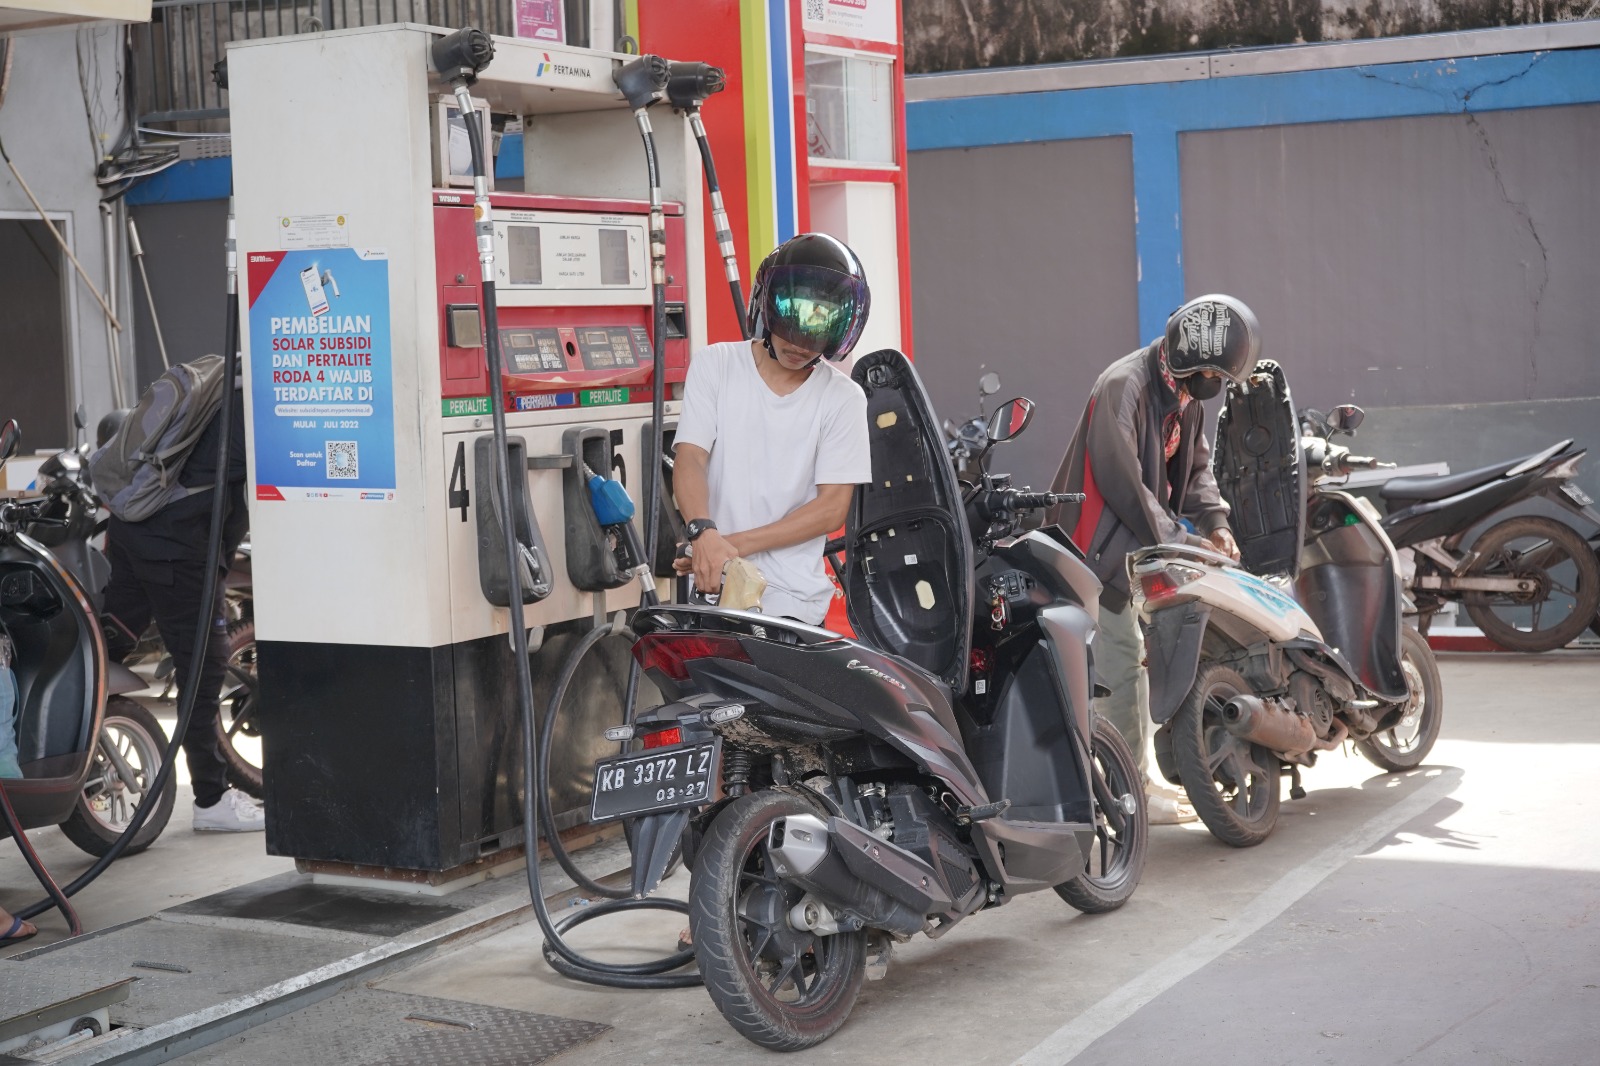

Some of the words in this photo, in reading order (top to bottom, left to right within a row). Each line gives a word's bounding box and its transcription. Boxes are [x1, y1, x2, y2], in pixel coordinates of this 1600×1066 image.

[554, 65, 591, 78] PERTAMINA
[271, 315, 371, 335] PEMBELIAN
[272, 338, 315, 351] SOLAR
[320, 336, 371, 350] SUBSIDI
[272, 354, 303, 368] DAN
[307, 353, 372, 367] PERTALITE
[273, 370, 312, 384] RODA
[316, 370, 325, 383] 4
[329, 369, 373, 384] WAJIB
[273, 386, 354, 402] TERDAFTAR
[358, 386, 373, 401] DI
[589, 389, 622, 404] PERTALITE
[450, 398, 488, 414] PERTALITE
[509, 397, 515, 409] 2
[521, 394, 558, 411] PERTAMAX
[293, 421, 316, 429] MULAI
[323, 421, 338, 429] JULI
[340, 420, 359, 429] 2022
[290, 451, 304, 459] Scan
[305, 451, 323, 459] untuk
[609, 428, 627, 489] 5
[296, 459, 317, 467] Daftar
[449, 441, 469, 522] 4
[602, 768, 625, 791] KB
[633, 758, 677, 785] 3372
[686, 751, 710, 775] LZ
